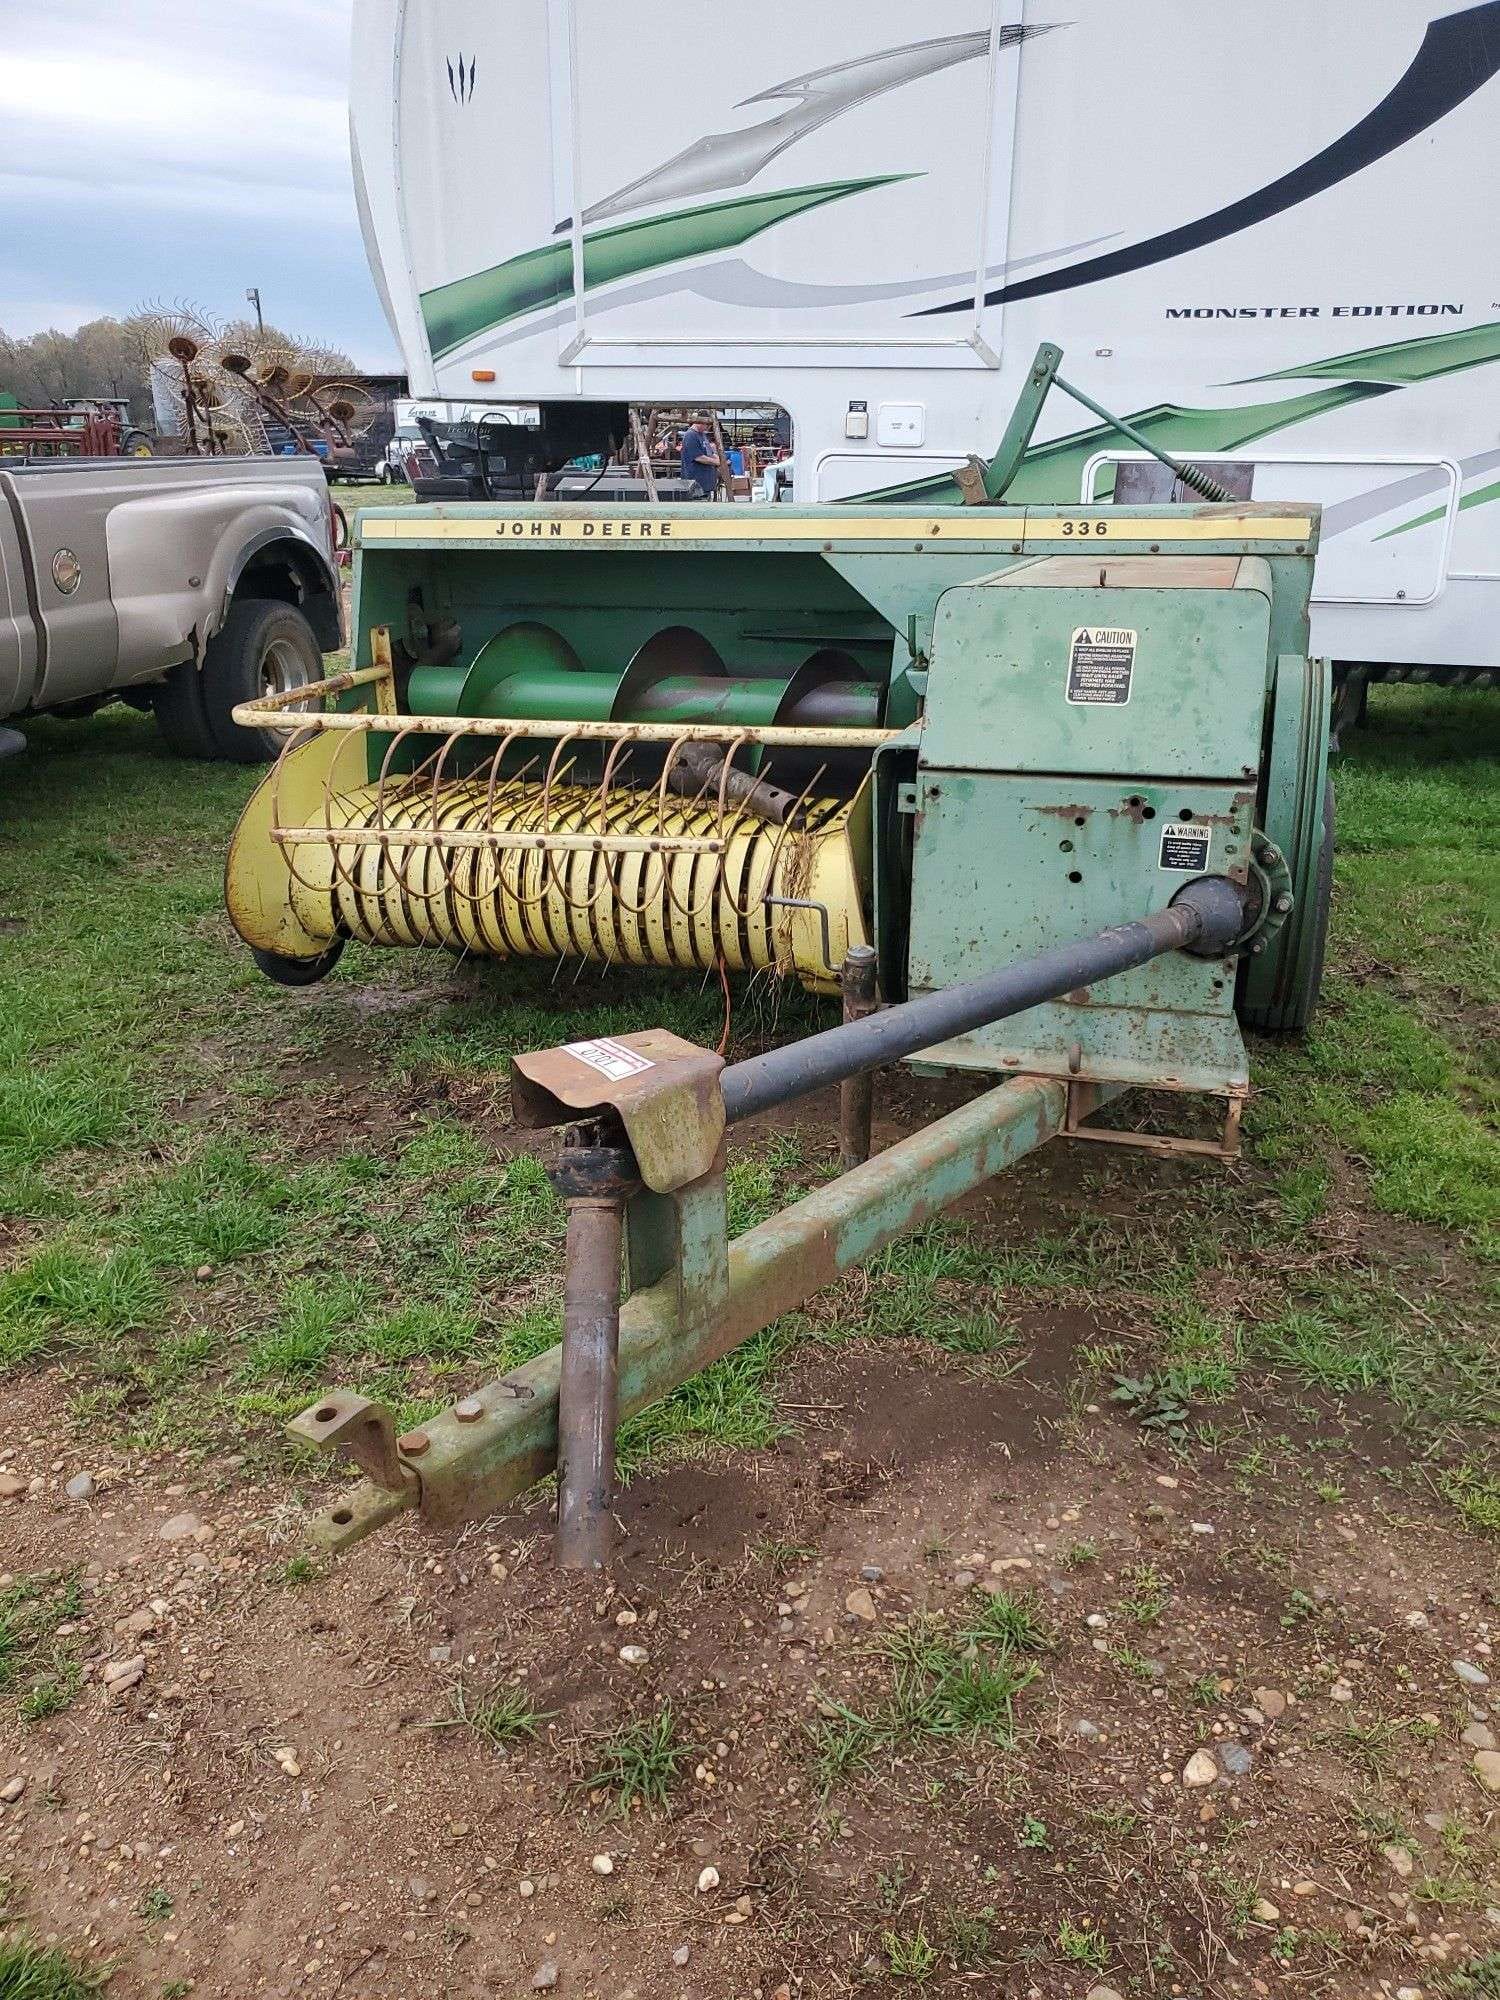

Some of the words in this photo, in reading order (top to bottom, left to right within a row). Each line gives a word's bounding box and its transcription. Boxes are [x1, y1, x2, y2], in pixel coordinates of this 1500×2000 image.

[1166, 307, 1319, 318] MONSTER
[1332, 304, 1463, 316] EDITION
[496, 523, 562, 536] JOHN
[583, 523, 671, 536] DEERE
[1062, 522, 1107, 535] 336
[1095, 630, 1132, 644] CAUTION
[1177, 827, 1208, 838] WARNING
[581, 1049, 617, 1065] 0701
